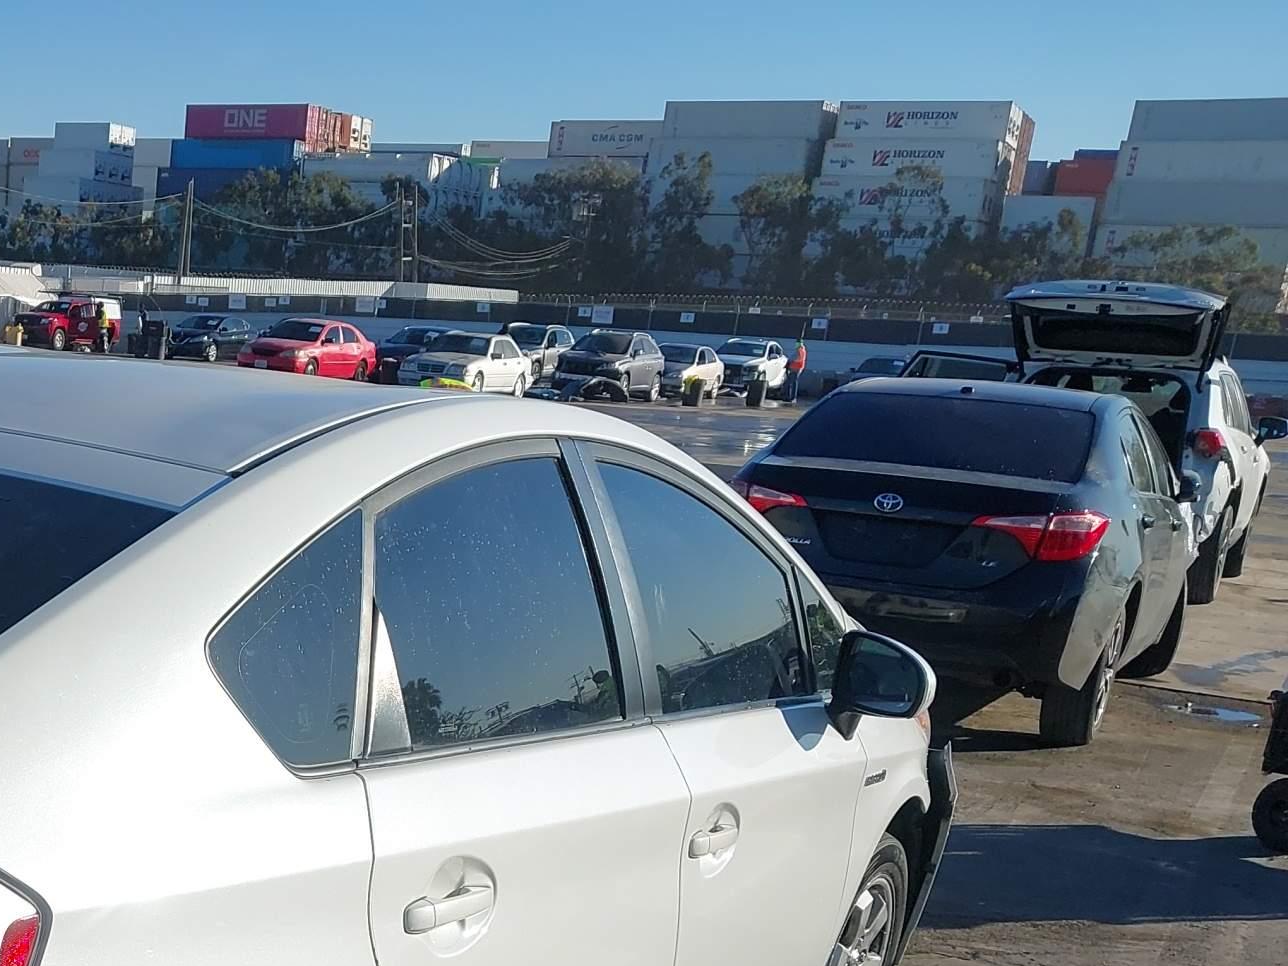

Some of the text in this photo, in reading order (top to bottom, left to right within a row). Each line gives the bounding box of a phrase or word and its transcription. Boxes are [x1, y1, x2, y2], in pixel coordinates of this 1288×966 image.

[223, 108, 268, 128] ONE
[905, 111, 959, 121] HORIZON
[591, 133, 644, 143] CMA CGM
[891, 149, 945, 159] HORIZON
